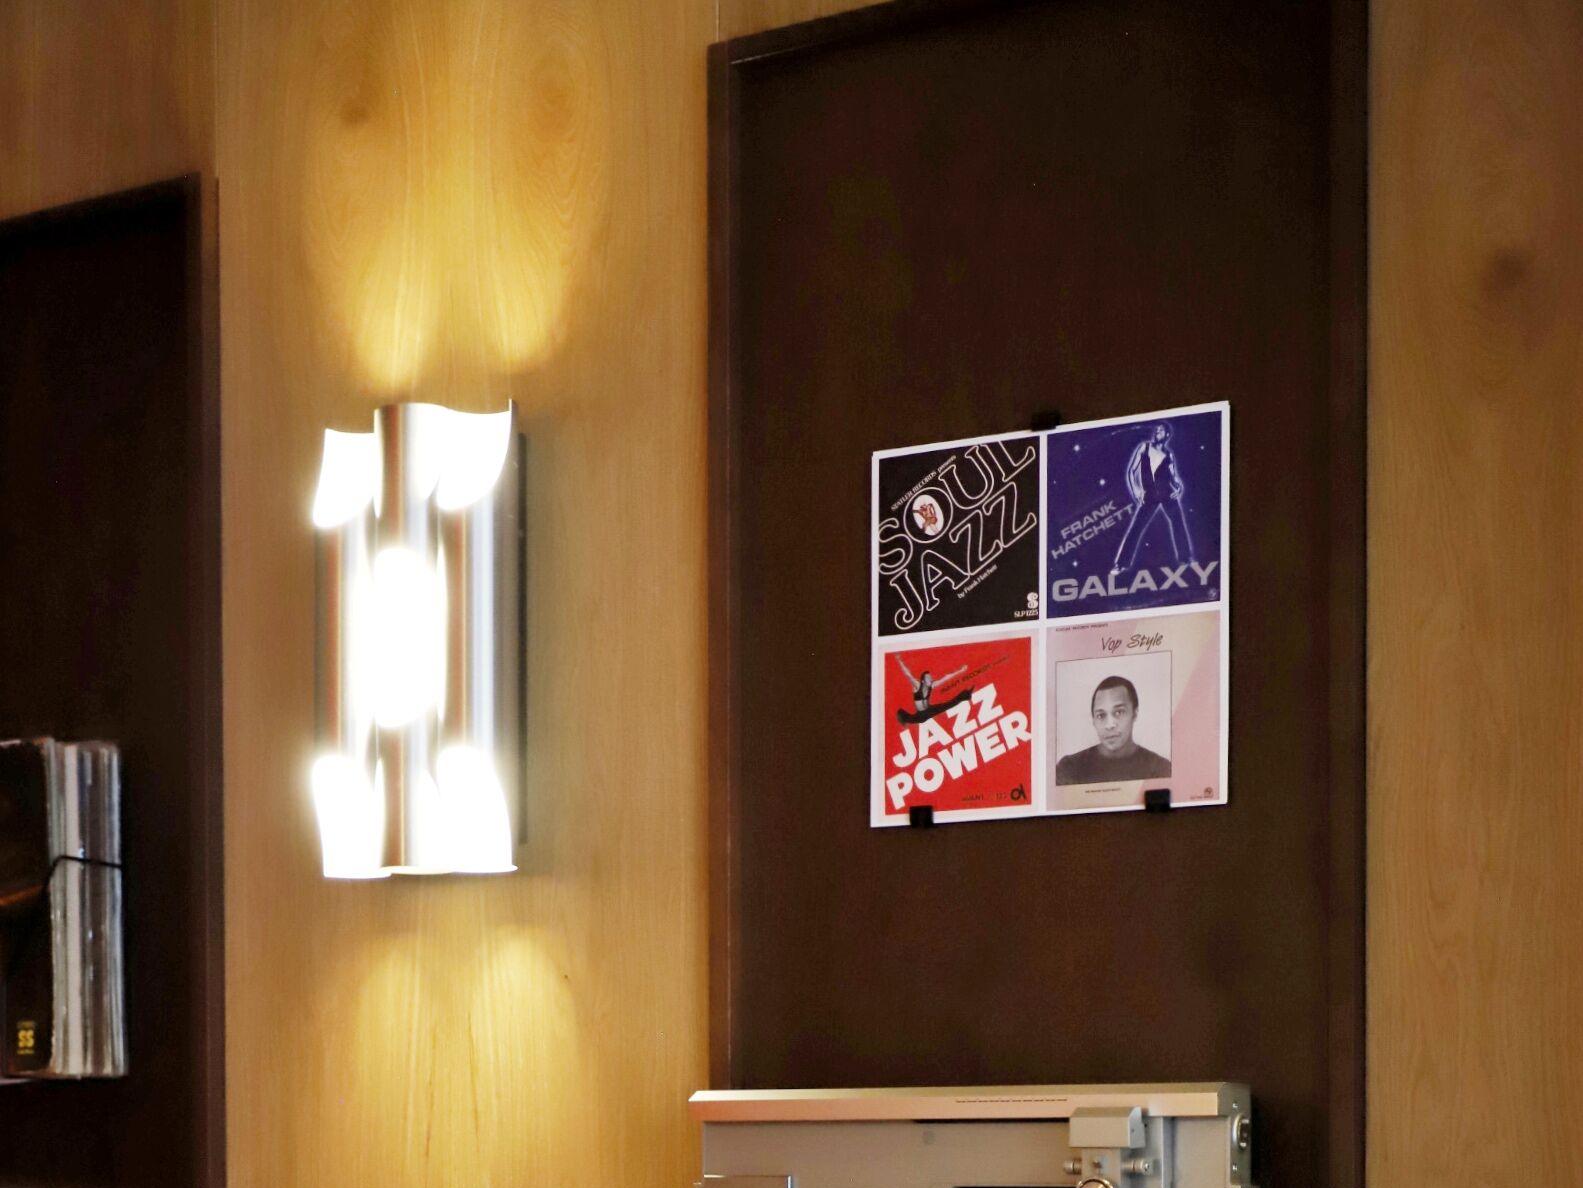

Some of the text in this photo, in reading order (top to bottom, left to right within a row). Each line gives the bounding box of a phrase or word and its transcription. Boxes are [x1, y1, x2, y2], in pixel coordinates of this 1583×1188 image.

[879, 441, 1036, 575] SOUL
[1051, 503, 1135, 560] HATCHETT
[1060, 501, 1117, 539] FRANK
[890, 481, 1037, 630] JAZZ
[1052, 561, 1219, 602] GALAXY
[1126, 632, 1164, 652] Style
[886, 711, 1032, 810] POWER
[893, 683, 1004, 768] JAZZ
